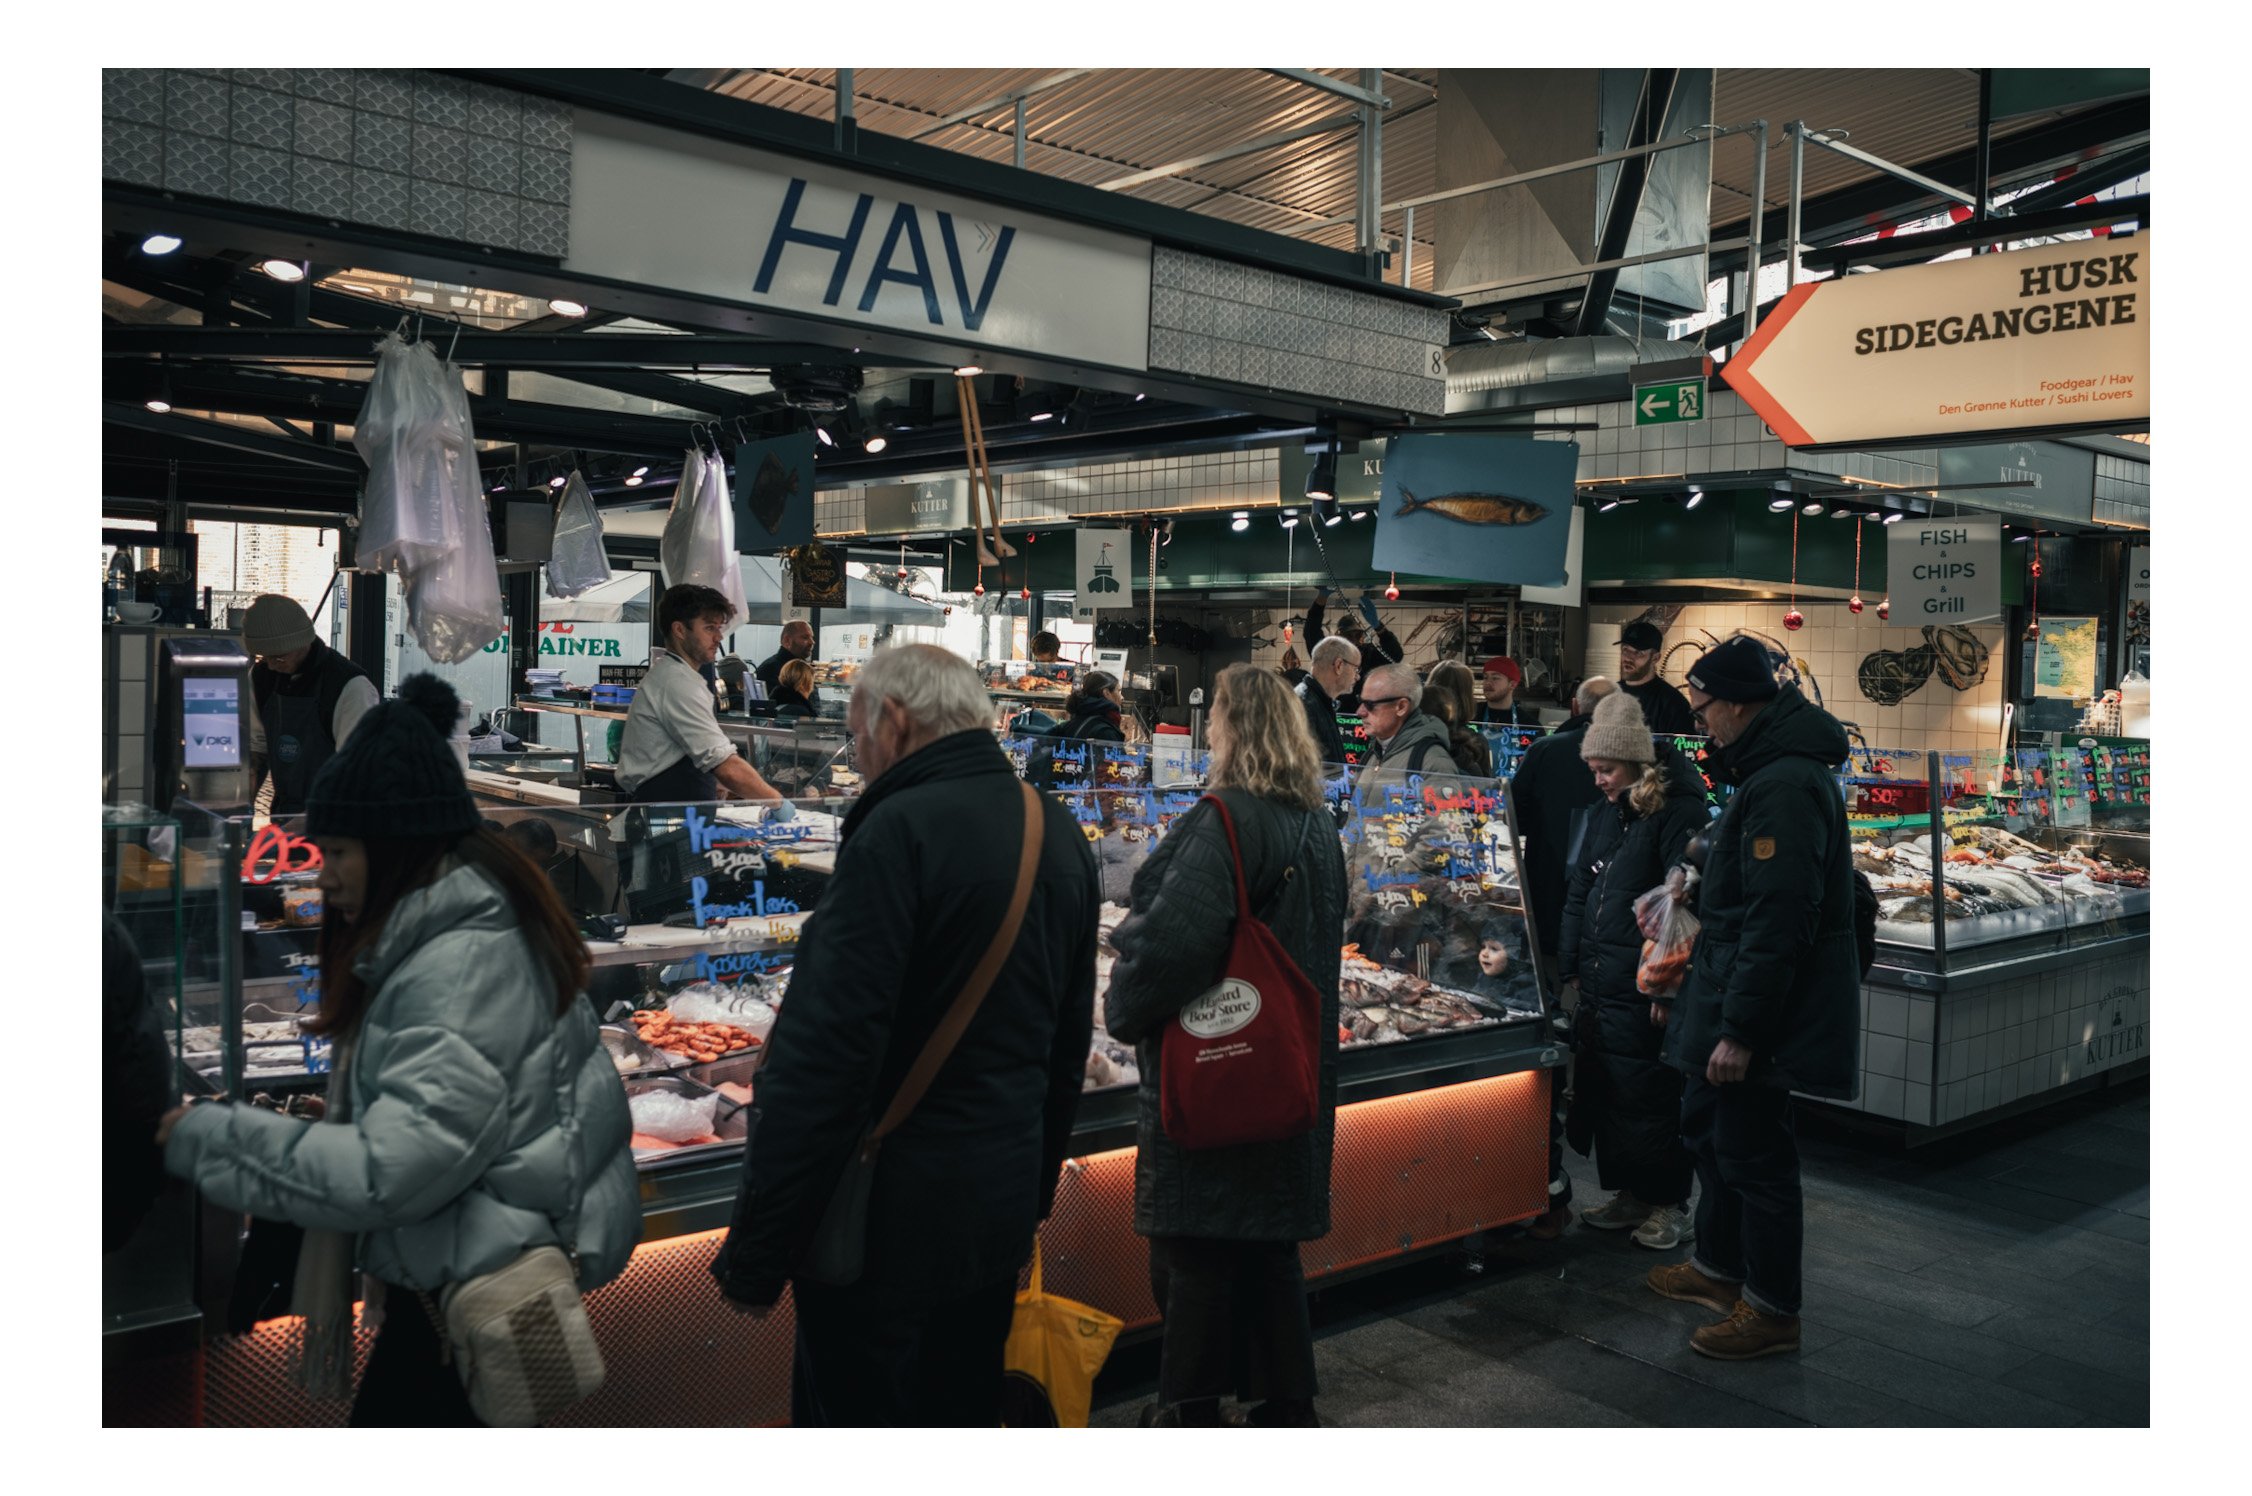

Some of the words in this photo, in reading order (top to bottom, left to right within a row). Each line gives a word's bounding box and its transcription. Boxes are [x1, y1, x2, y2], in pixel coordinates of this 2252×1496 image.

[753, 177, 1017, 332] HAV
[2019, 252, 2139, 298] HUSK
[1855, 293, 2136, 356] SIDEGANGENE
[1432, 351, 1441, 375] 8
[2040, 376, 2097, 392] Foodgear
[2100, 375, 2106, 387] /
[2109, 374, 2134, 386] Hav
[1939, 405, 1962, 416] Den
[1964, 400, 2007, 413] Grønne
[2010, 396, 2045, 409] Kutter
[2057, 391, 2089, 405] Sushi
[2093, 389, 2134, 402] Lovers
[2000, 466, 2042, 489] KUTTER
[911, 498, 948, 514] KUTTER
[1921, 529, 1967, 546] FISH
[1913, 562, 1976, 580] CHIPS
[1940, 585, 1947, 593] &
[1923, 597, 1964, 613] Grill
[1219, 1001, 1251, 1016] Store
[2087, 1025, 2143, 1065] KUTTER
